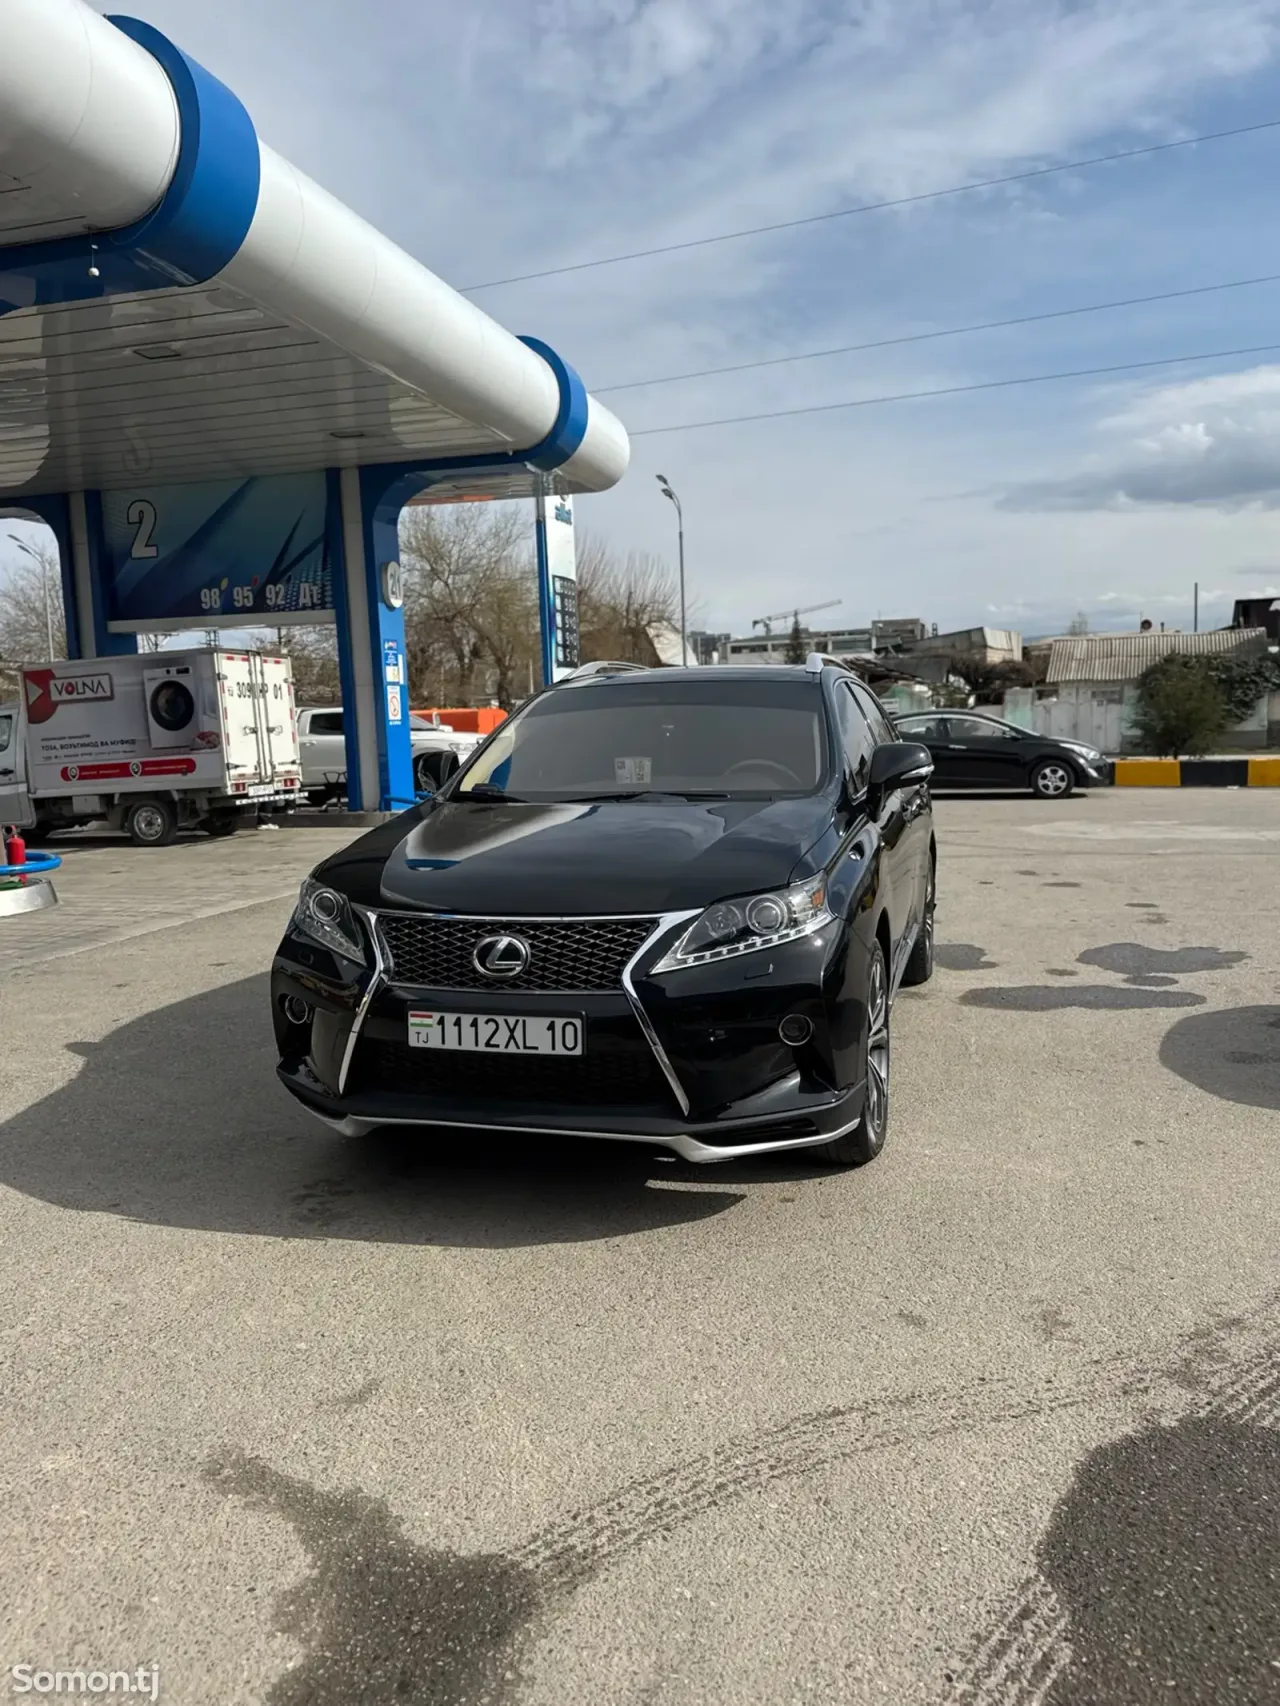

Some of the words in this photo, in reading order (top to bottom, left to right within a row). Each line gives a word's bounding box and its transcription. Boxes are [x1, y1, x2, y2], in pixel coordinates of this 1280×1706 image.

[127, 499, 158, 560] 2
[200, 588, 220, 610] 98
[233, 586, 253, 607] 95
[265, 584, 285, 605] 92
[53, 679, 107, 696] VOLNA
[273, 683, 283, 700] 01
[415, 1031, 429, 1044] TJ
[436, 1015, 539, 1050] 1112XL
[546, 1020, 578, 1052] 10
